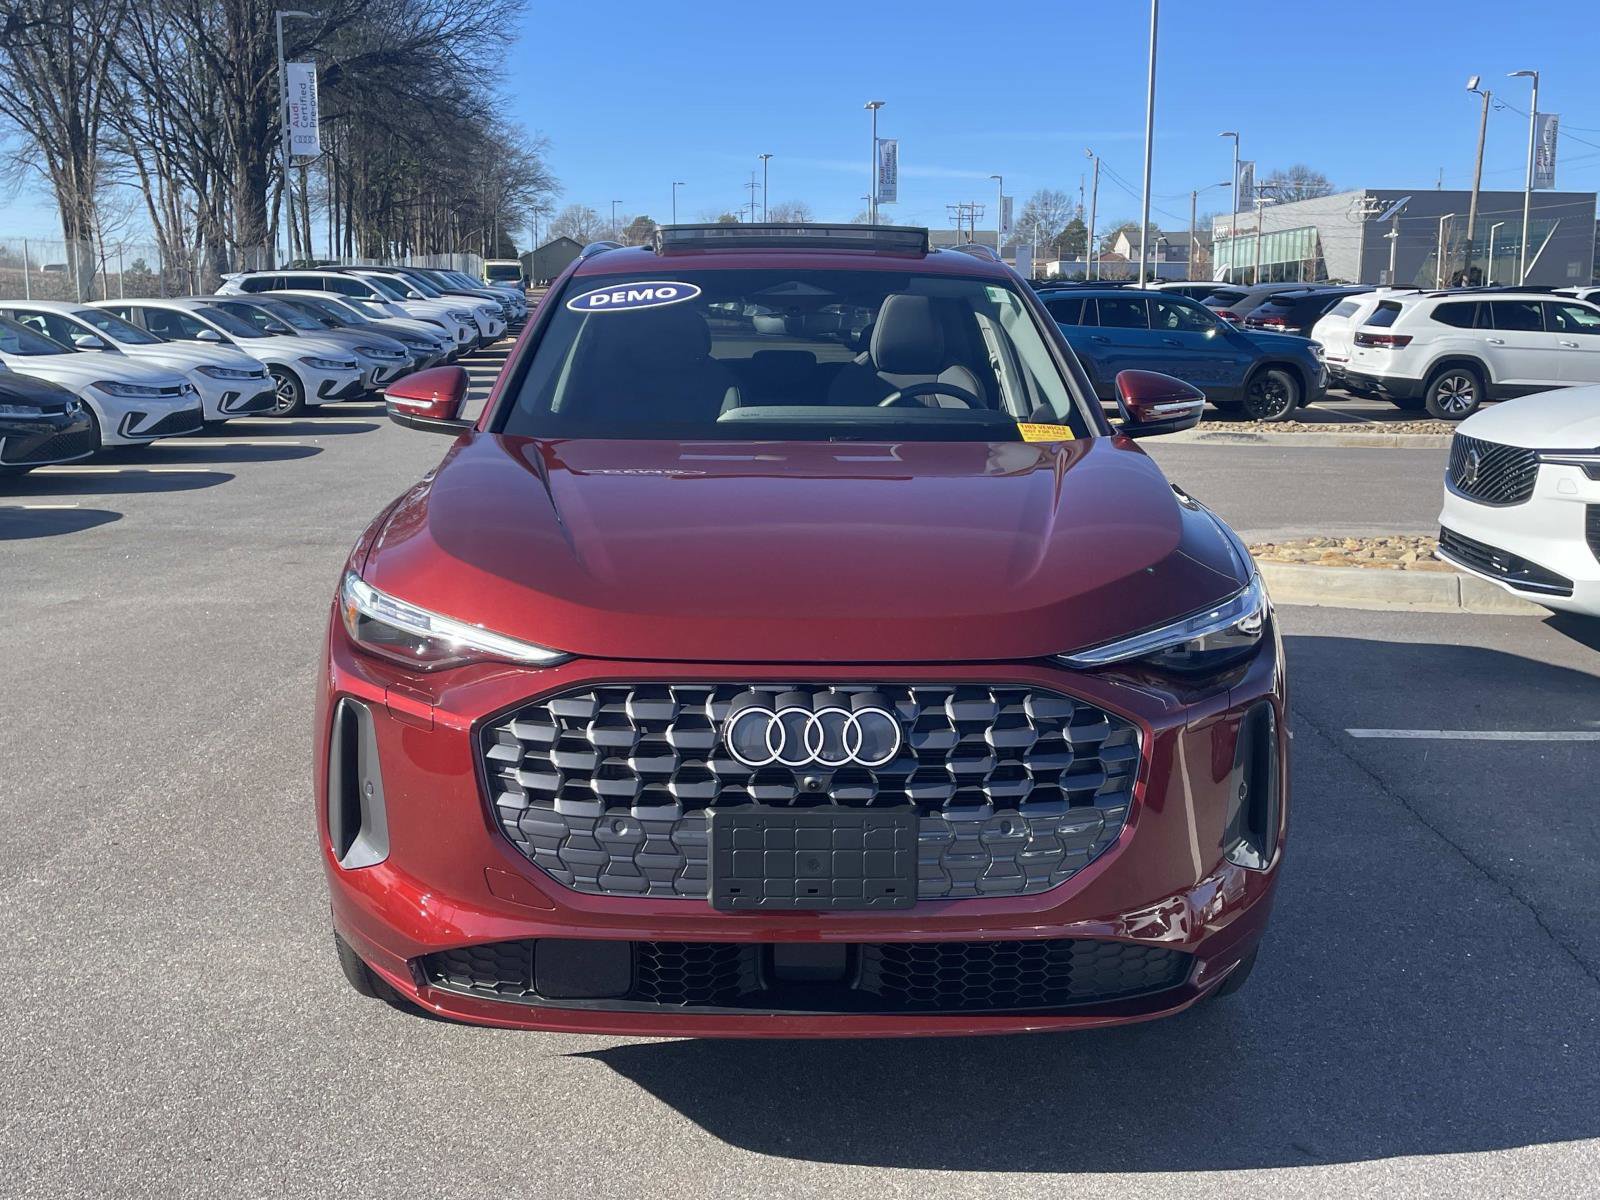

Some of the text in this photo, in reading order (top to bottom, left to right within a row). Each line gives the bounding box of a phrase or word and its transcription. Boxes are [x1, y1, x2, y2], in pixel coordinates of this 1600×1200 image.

[291, 102, 300, 128] Audi
[299, 83, 309, 128] Certified
[307, 71, 317, 128] Pre-owned
[589, 287, 678, 306] DEMO
